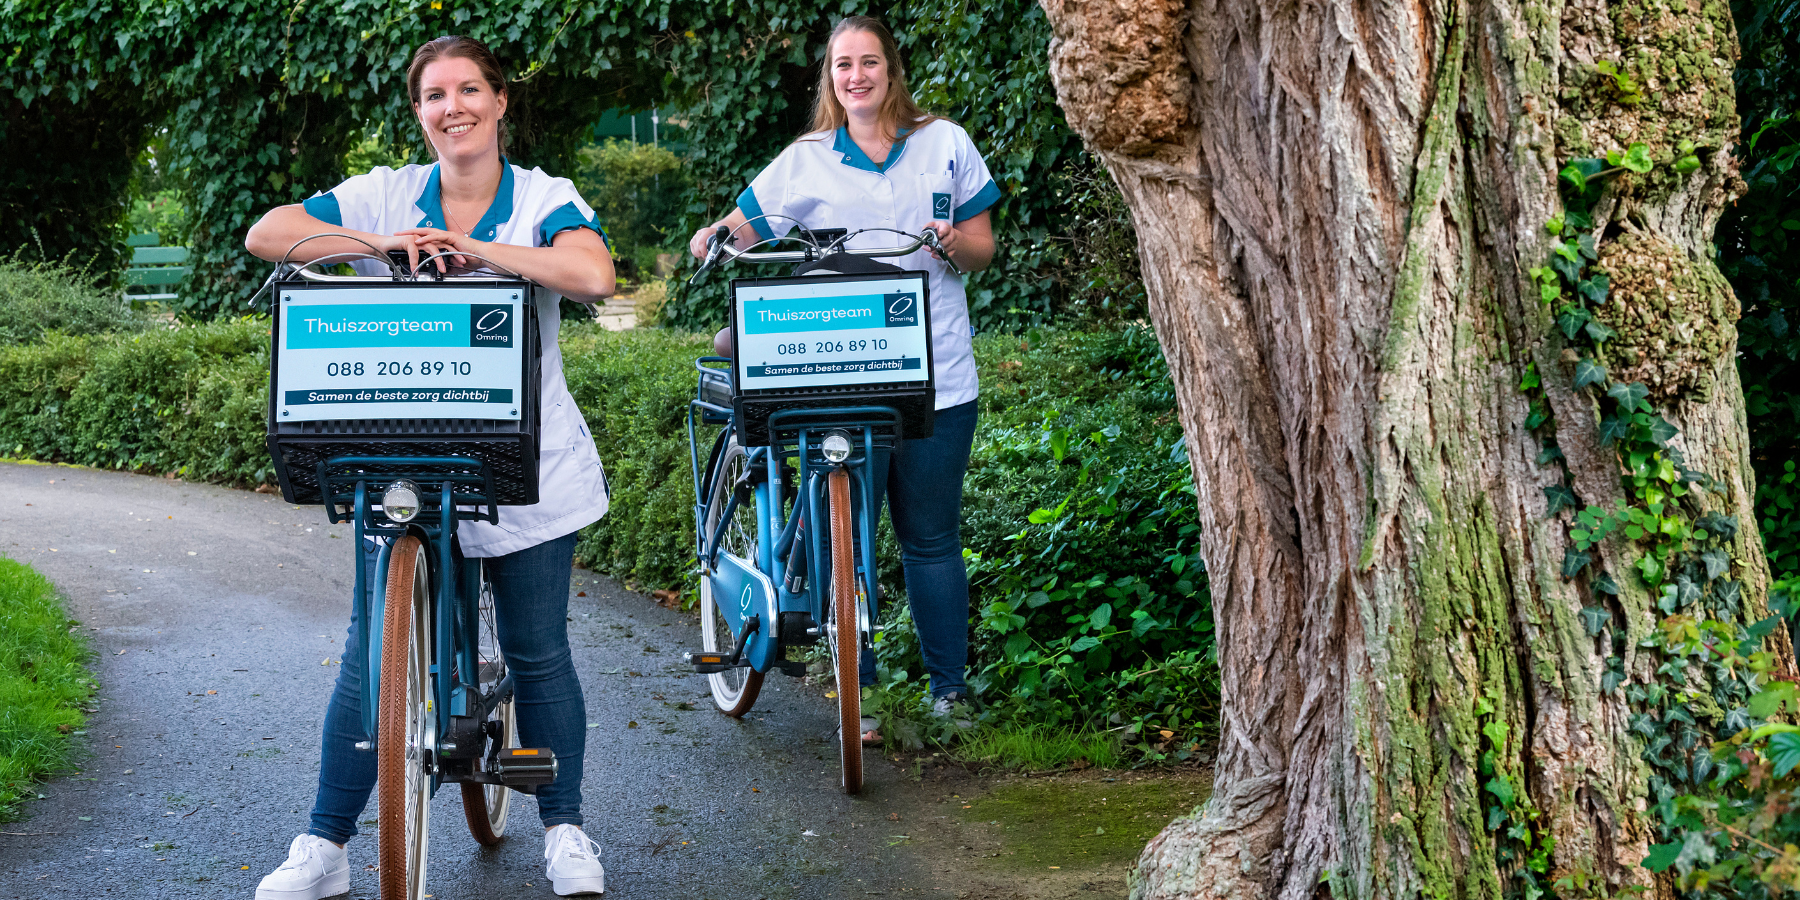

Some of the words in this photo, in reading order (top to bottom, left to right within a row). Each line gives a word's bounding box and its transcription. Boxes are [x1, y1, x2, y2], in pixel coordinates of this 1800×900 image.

[757, 307, 872, 322] Thuiszorgteam
[304, 318, 453, 336] Thuiszorgteam
[476, 334, 508, 343] Omring
[777, 343, 806, 355] 088
[815, 341, 844, 353] 206
[848, 339, 867, 351] 89
[871, 338, 888, 350] 10
[327, 362, 365, 377] 088
[376, 361, 414, 376] 206
[420, 361, 444, 376] 89
[450, 361, 472, 376] 10
[764, 366, 799, 375] Samen
[800, 364, 814, 373] de
[815, 363, 842, 372] beste
[843, 363, 865, 372] zorg
[866, 360, 903, 371] dichtbij
[307, 392, 353, 402] Samen
[355, 391, 372, 401] de
[374, 390, 409, 400] beste
[411, 392, 440, 402] zorg
[443, 390, 489, 402] dichtbij
